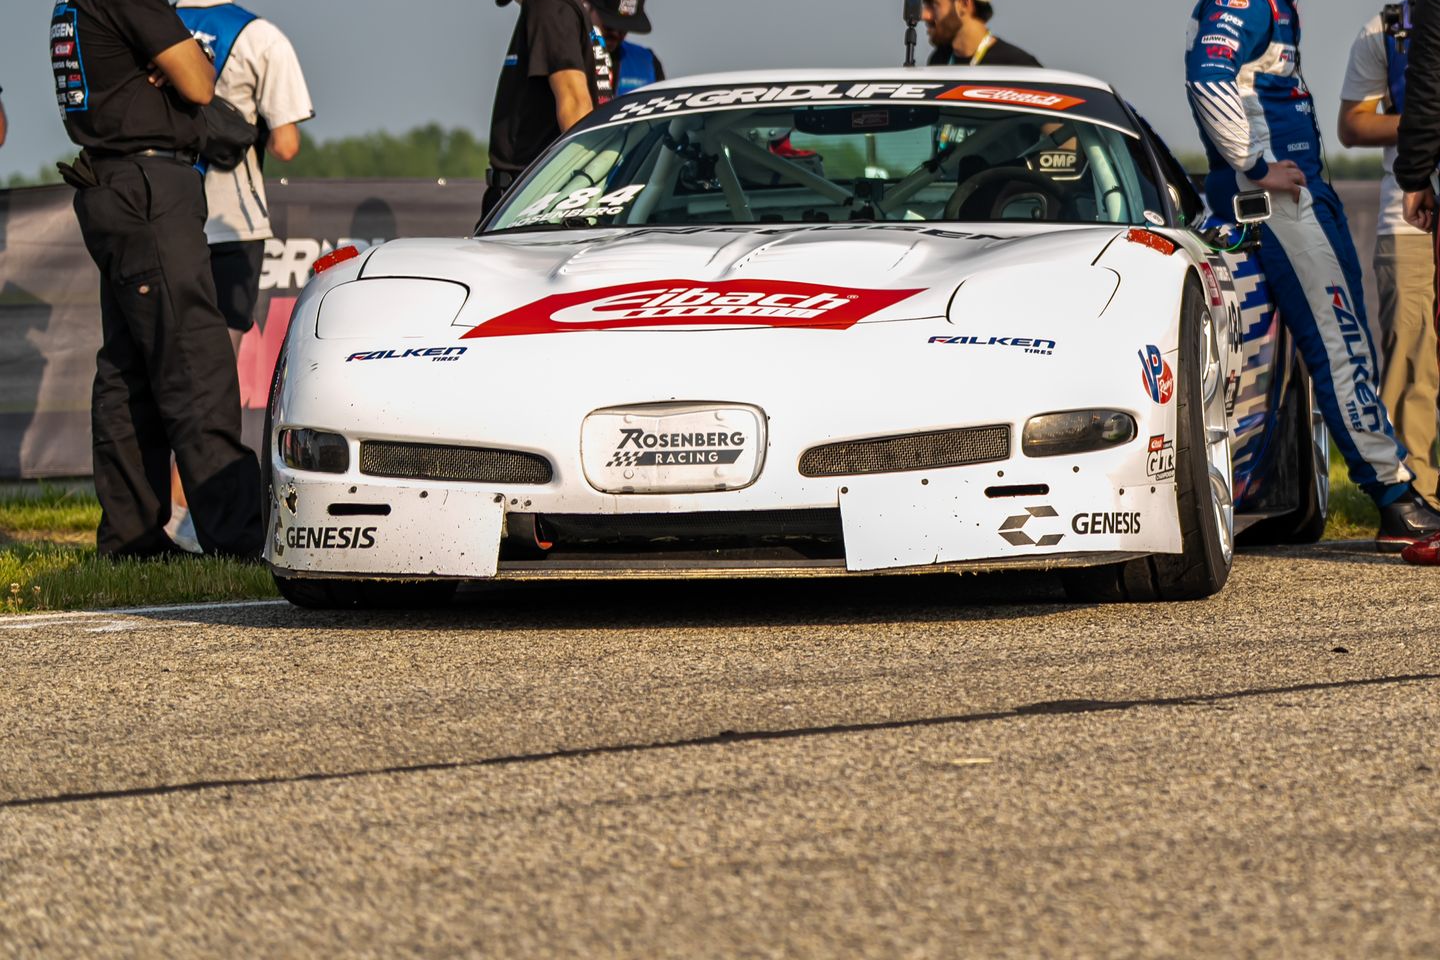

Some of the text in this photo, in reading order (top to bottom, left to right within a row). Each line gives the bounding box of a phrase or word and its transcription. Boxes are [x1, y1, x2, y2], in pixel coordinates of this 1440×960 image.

[685, 84, 944, 108] GRIDLIFE
[1039, 153, 1077, 167] OMP
[515, 184, 646, 218] 484
[550, 287, 850, 324] Eibach
[345, 346, 468, 362] FALKEN
[927, 335, 1056, 350] FALKEN
[1023, 348, 1053, 356] TIRES
[1325, 280, 1381, 434] FALKEN
[1137, 344, 1163, 404] VP
[617, 427, 746, 449] ROSENBERG
[655, 451, 719, 465] RACING
[1071, 512, 1141, 536] GENESIS
[286, 526, 378, 549] GENESIS
